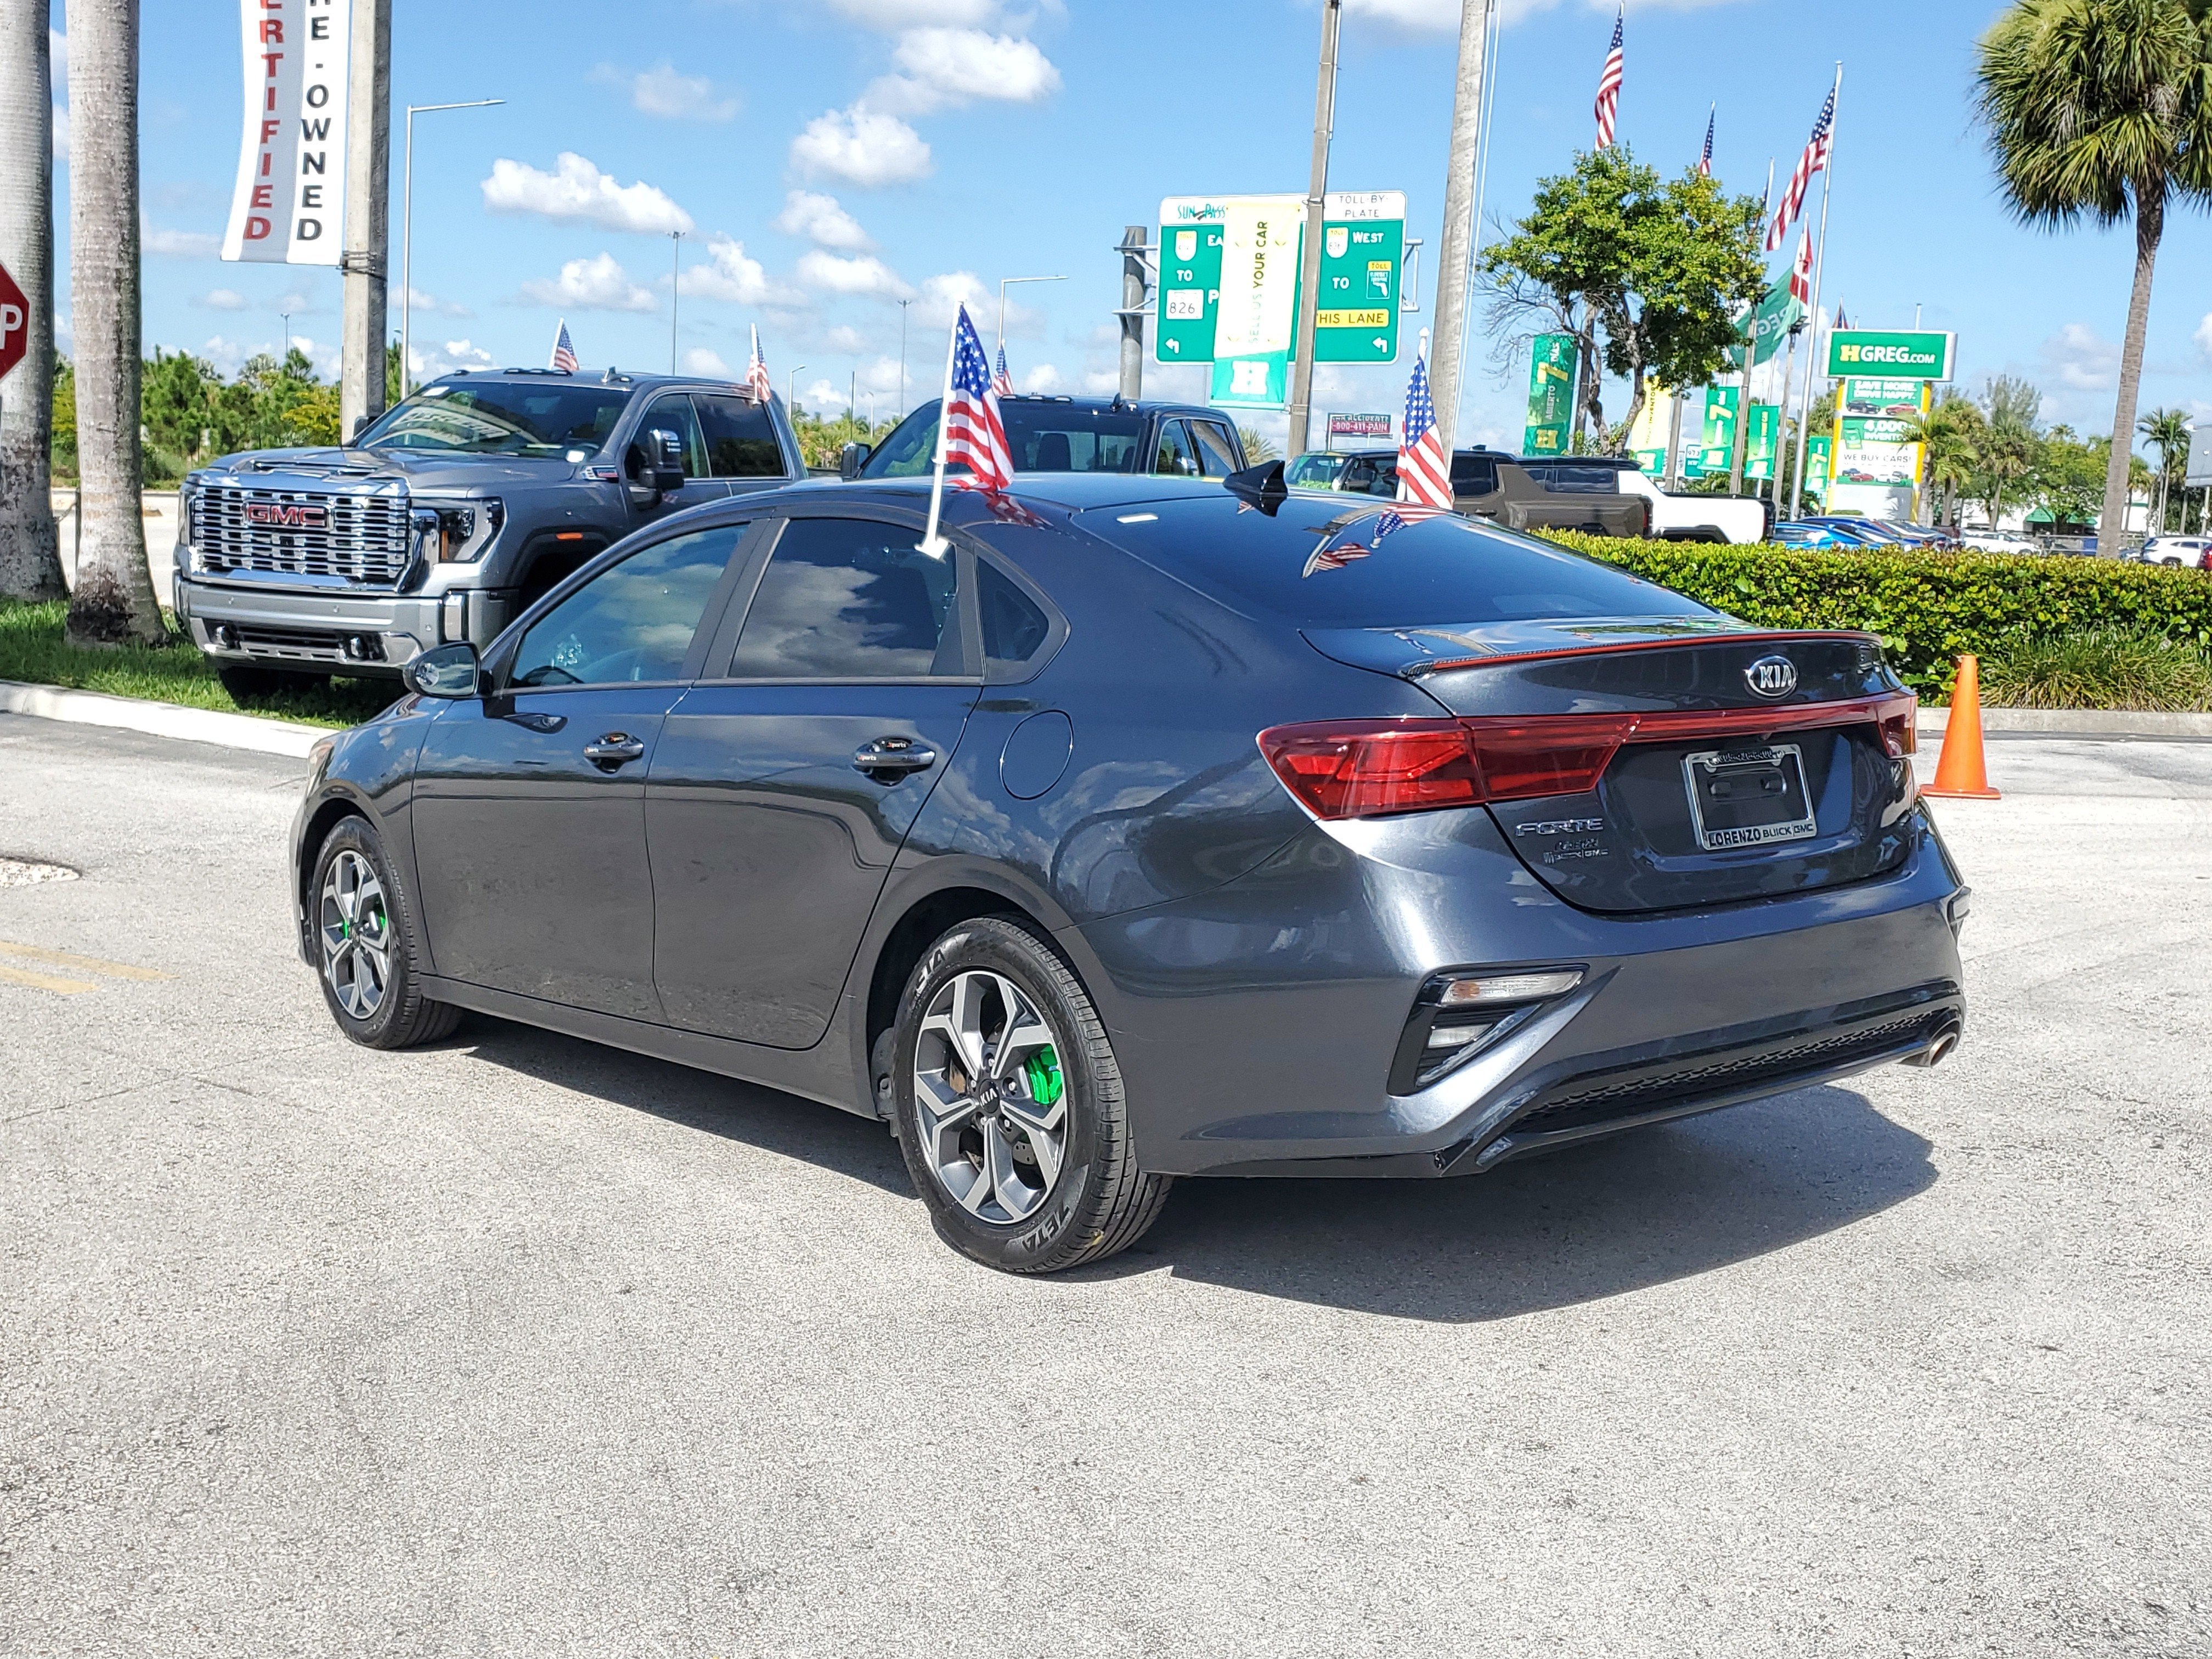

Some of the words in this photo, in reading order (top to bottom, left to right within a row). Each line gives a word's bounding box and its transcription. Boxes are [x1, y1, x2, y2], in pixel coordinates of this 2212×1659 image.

[297, 0, 331, 240] E-OWNED
[1345, 209, 1379, 218] PLATE
[1207, 234, 1223, 247] EA
[1256, 221, 1268, 248] CAR
[1352, 232, 1384, 244] WEST
[1176, 269, 1193, 281] TO
[1253, 252, 1265, 289] YOUR
[1332, 277, 1350, 289] TO
[1170, 302, 1195, 314] 826
[1317, 313, 1340, 324] HIS
[1348, 313, 1384, 324] LANE
[1537, 362, 1568, 384] 7
[1535, 429, 1558, 449] H
[248, 504, 325, 527] GMC
[1758, 664, 1792, 689] KIA
[1515, 818, 1604, 837] FORTE
[1708, 828, 1761, 847] LORENZO
[1762, 826, 1791, 838] BUICK
[1793, 823, 1814, 834] GMC
[980, 1088, 997, 1106] KIA
